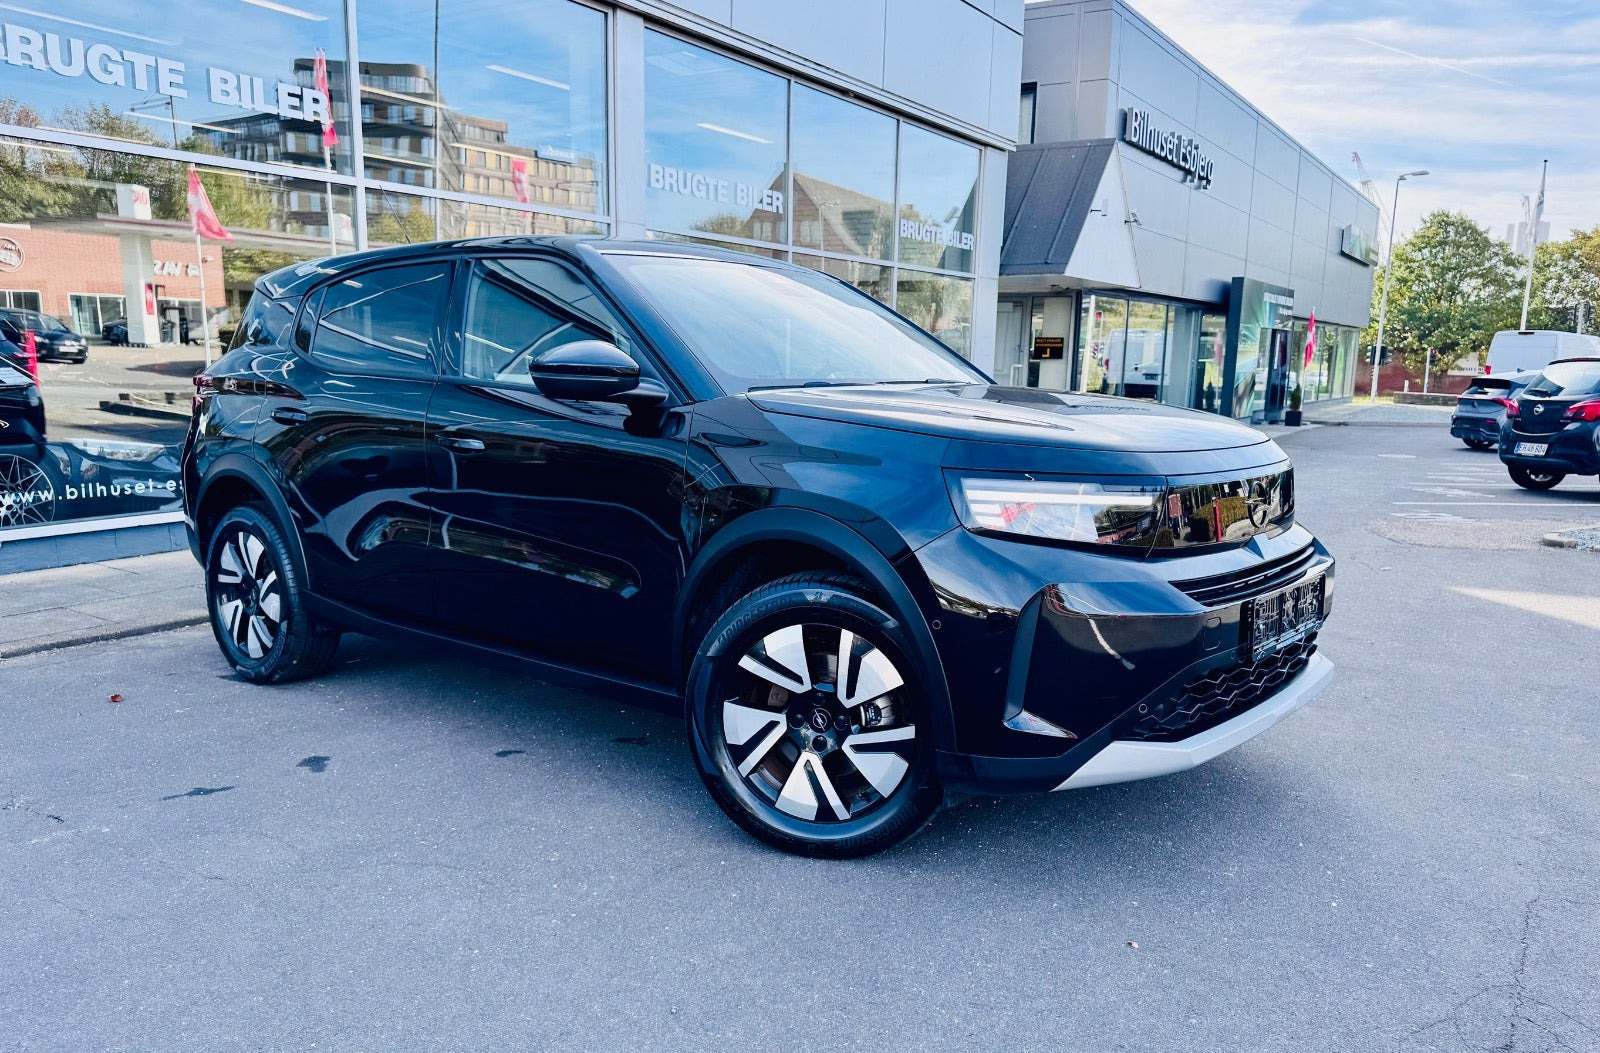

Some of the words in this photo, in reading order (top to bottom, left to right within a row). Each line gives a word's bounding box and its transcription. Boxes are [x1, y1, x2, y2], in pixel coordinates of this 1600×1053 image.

[208, 66, 330, 126] BILER
[1127, 106, 1178, 164] Bilhuset
[1177, 135, 1214, 189] Esbjerg
[648, 163, 729, 204] BRUGTE
[735, 182, 784, 215] BILER
[900, 218, 944, 247] BRUGTE
[946, 230, 975, 252] BILER
